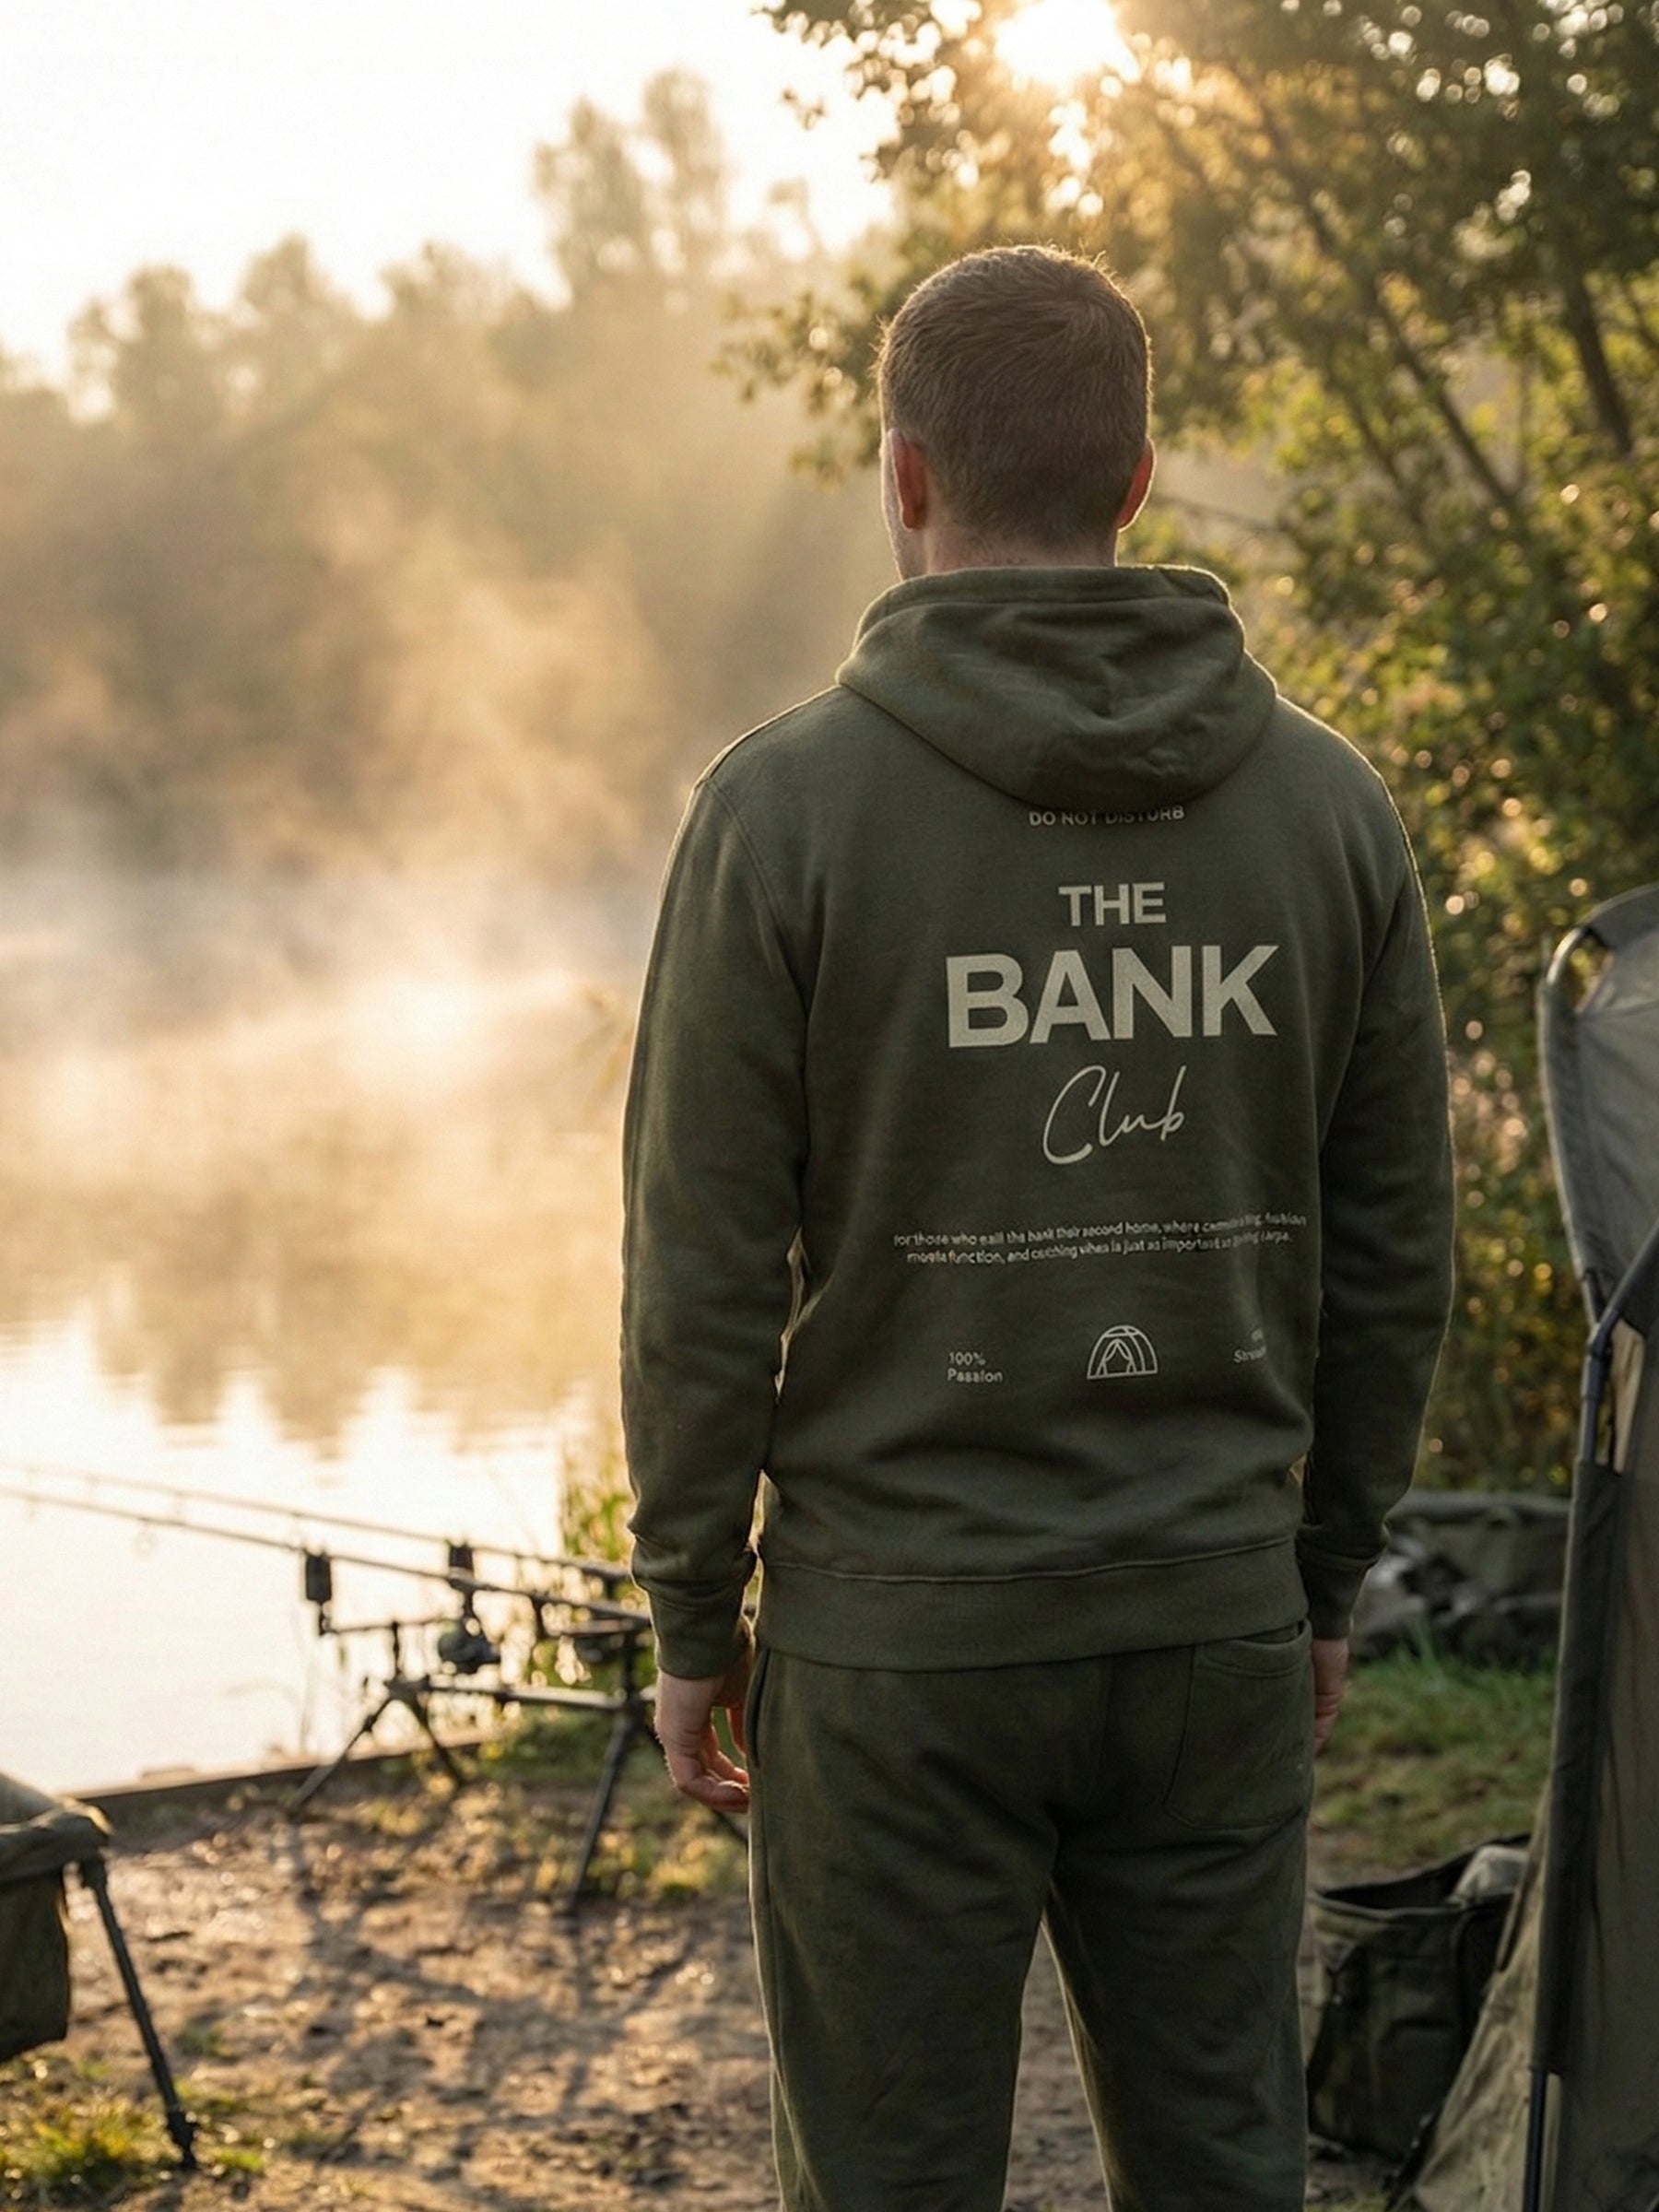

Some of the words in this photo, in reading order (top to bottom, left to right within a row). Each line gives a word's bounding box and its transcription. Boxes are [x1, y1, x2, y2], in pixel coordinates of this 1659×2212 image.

[1029, 810, 1056, 826] DO
[1061, 811, 1097, 825] NOT
[1105, 805, 1185, 824] DISTURB
[1058, 882, 1166, 926] THE
[946, 945, 1278, 1048] BANK
[1043, 1065, 1186, 1164] Club
[948, 1351, 986, 1366] 100%
